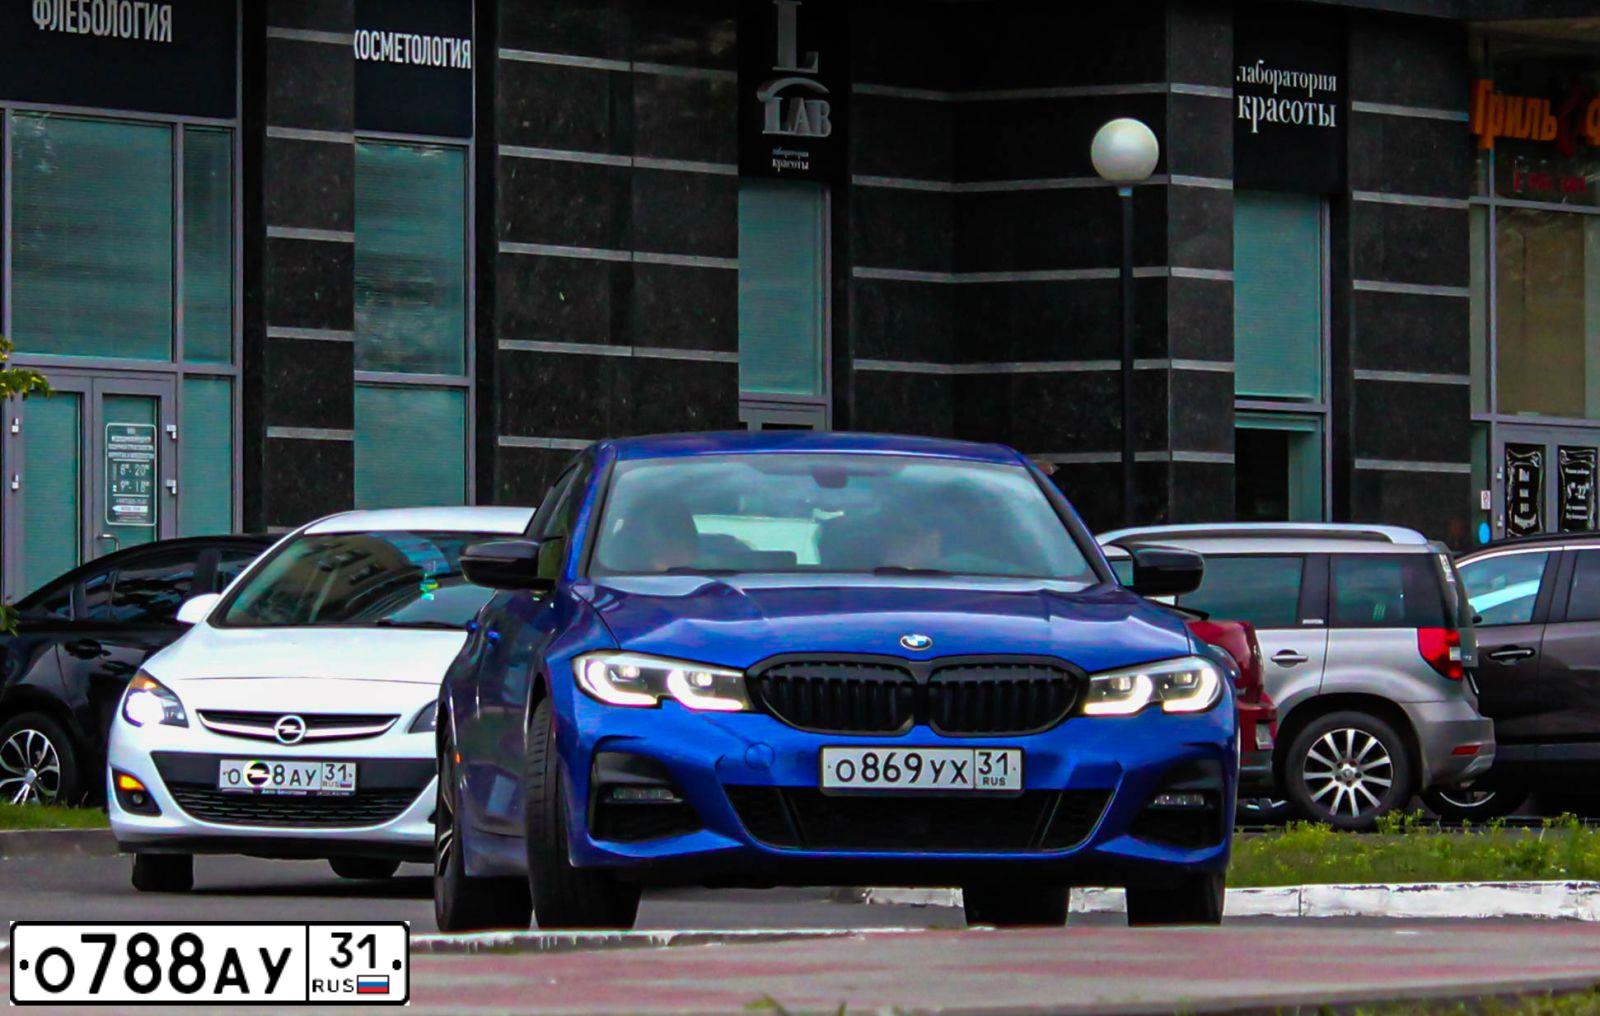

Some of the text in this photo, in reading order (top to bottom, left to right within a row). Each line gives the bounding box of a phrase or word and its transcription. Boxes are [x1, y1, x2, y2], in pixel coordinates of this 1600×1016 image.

[32, 0, 173, 43] ФЛЕБОЛОГИЯ
[1236, 60, 1337, 97] лаборатория
[762, 97, 832, 138] LAB
[1238, 95, 1337, 133] красоты
[1472, 79, 1558, 149] Гриль
[228, 763, 347, 787] О8АУ 31
[978, 752, 1009, 776] 31
[982, 777, 1006, 786] RUS
